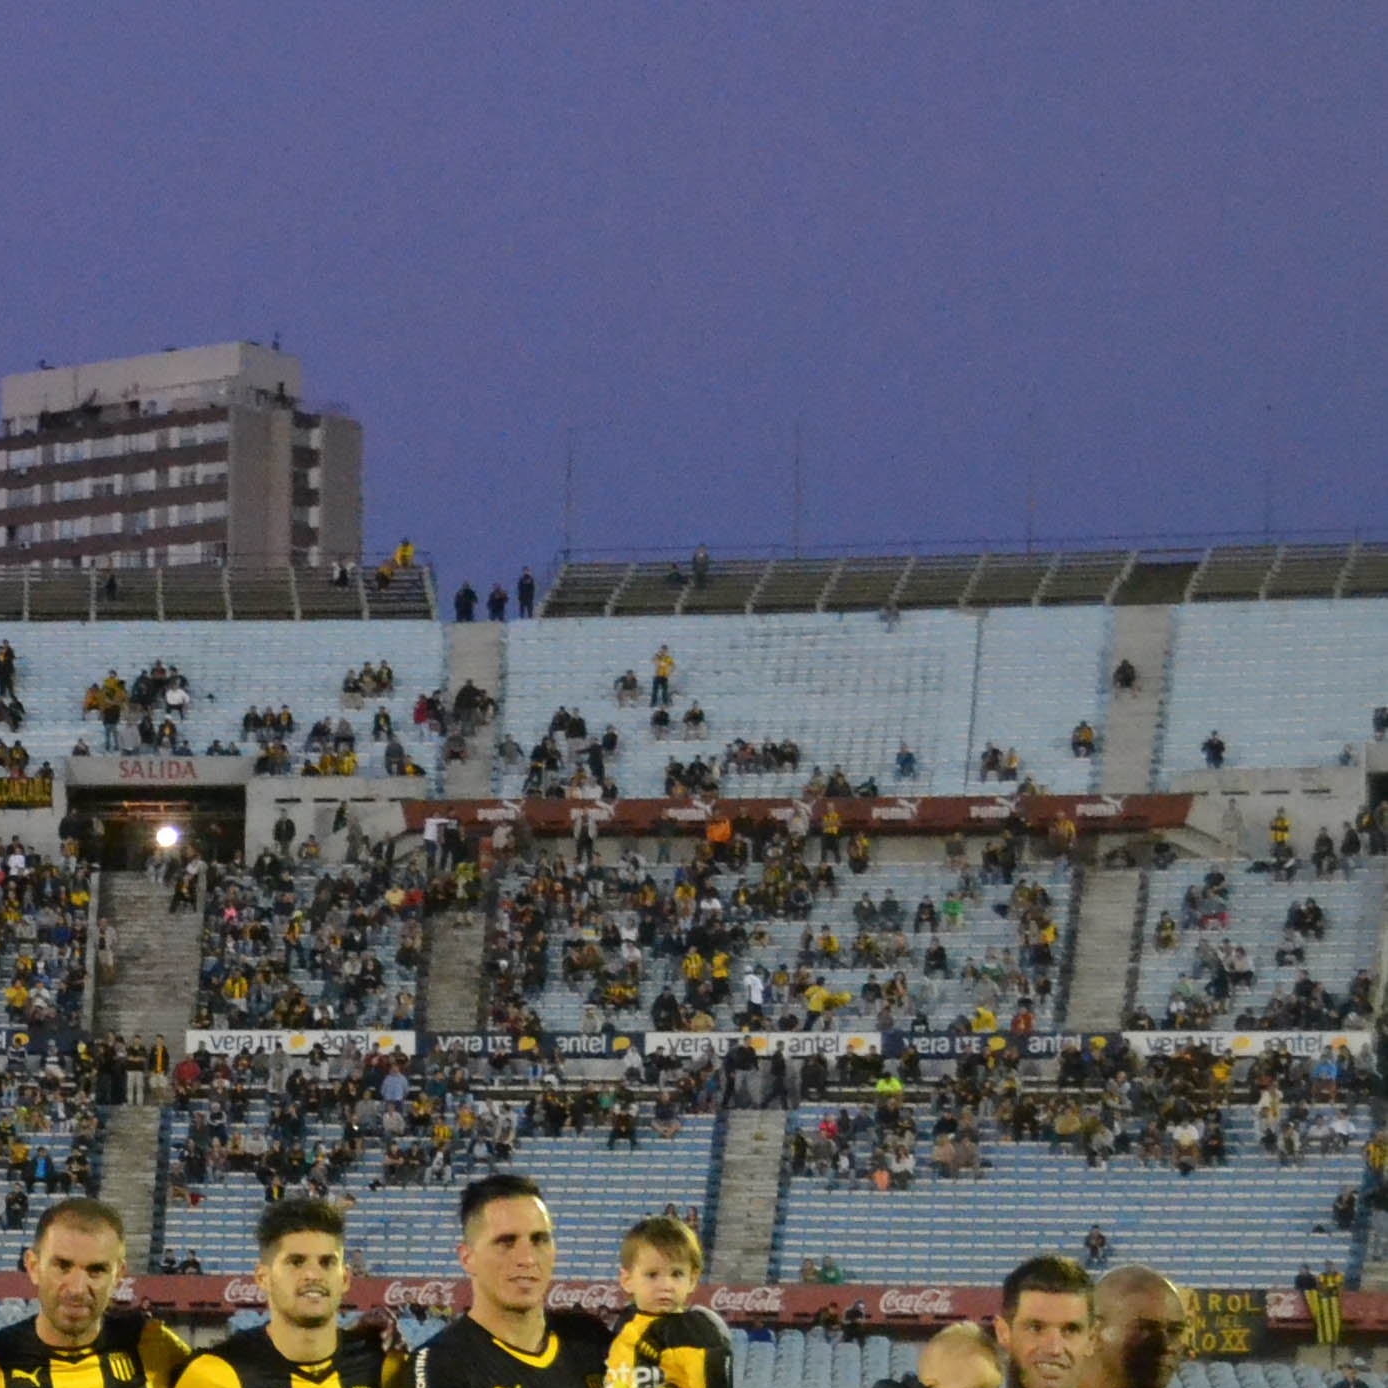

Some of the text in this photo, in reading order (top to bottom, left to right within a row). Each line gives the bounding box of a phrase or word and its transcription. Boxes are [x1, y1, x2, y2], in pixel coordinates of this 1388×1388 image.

[119, 760, 197, 779] SALIDA
[210, 1033, 253, 1051] vera
[487, 1035, 513, 1053] LTE
[555, 1034, 607, 1052] antel
[667, 1036, 714, 1054] vera
[788, 1036, 840, 1055] antel
[548, 1281, 619, 1308] Coca-Cola
[711, 1286, 786, 1312] Coca-Cola
[879, 1288, 952, 1315] Coca-Cola
[1187, 1290, 1262, 1313] AROL
